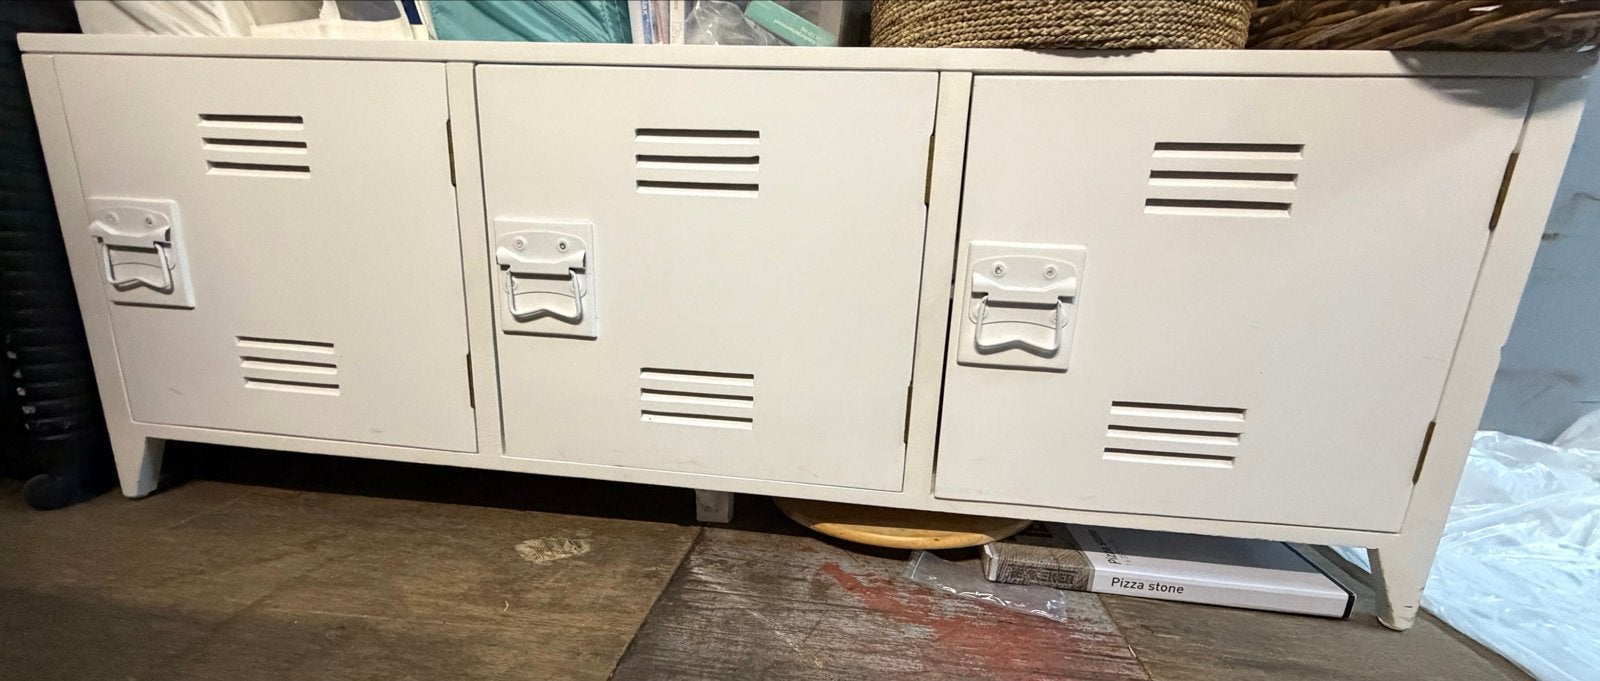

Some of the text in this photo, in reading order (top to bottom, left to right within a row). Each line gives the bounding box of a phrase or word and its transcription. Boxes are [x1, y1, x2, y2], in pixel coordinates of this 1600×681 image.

[1100, 546, 1122, 564] Pizza
[1111, 576, 1184, 594] Pizza stone
